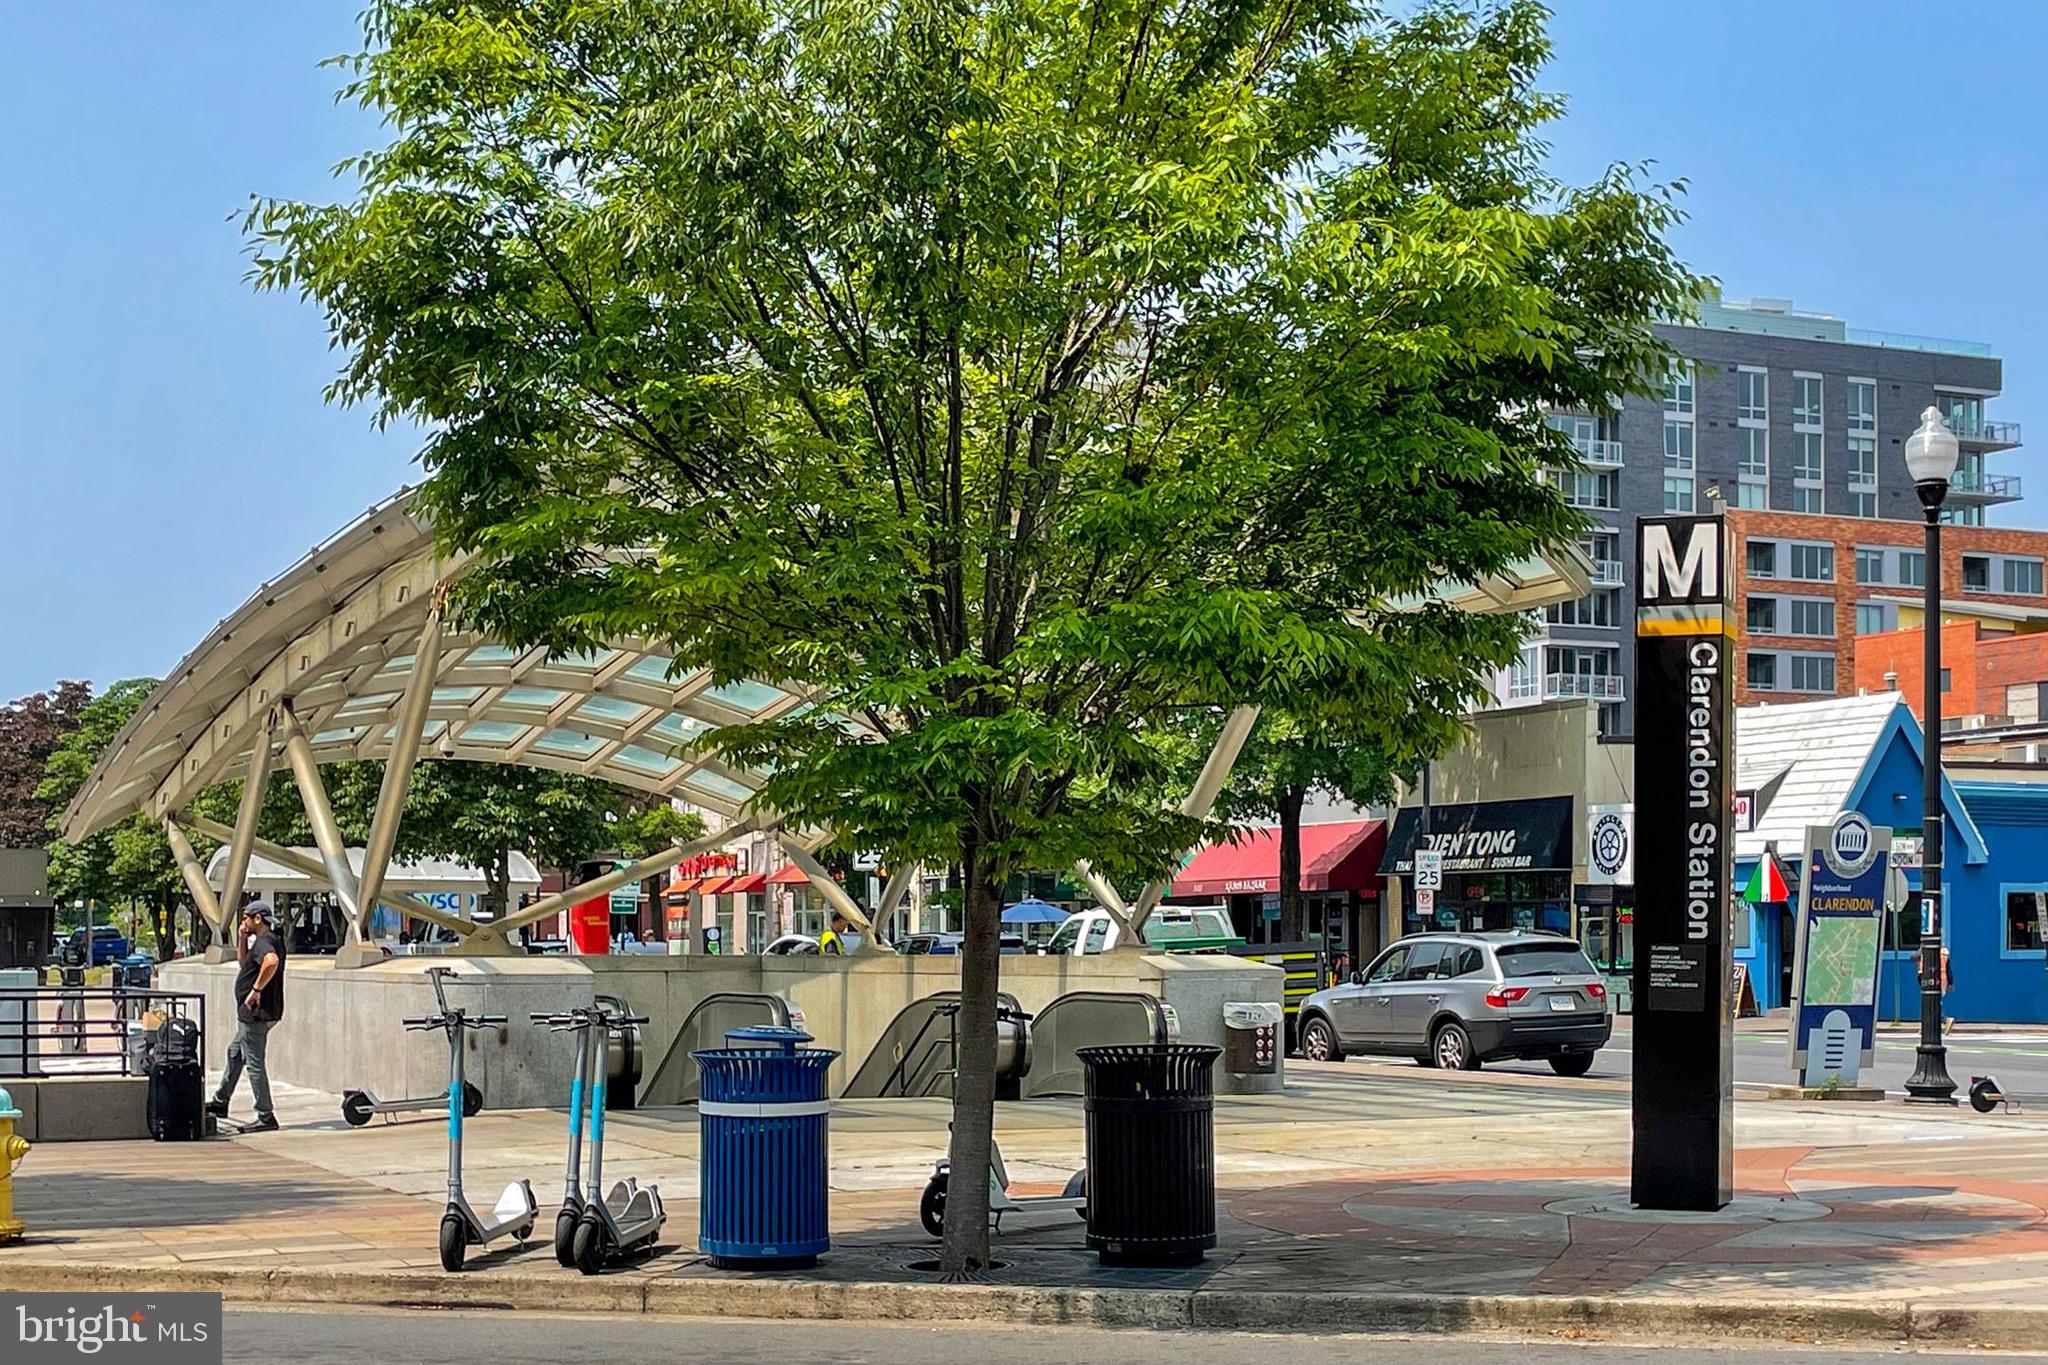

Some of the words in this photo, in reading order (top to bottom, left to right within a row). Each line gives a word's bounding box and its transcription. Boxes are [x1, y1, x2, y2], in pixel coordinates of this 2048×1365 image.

[1643, 523, 1718, 599] M
[1689, 642, 1718, 808] Clarendon
[1465, 829, 1516, 856] TONG
[1441, 858, 1485, 870] ESTAURANT
[1418, 871, 1439, 886] 25
[1688, 822, 1717, 939] Station
[1812, 884, 1852, 894] Neighborhood
[1811, 897, 1875, 911] CLARENDON
